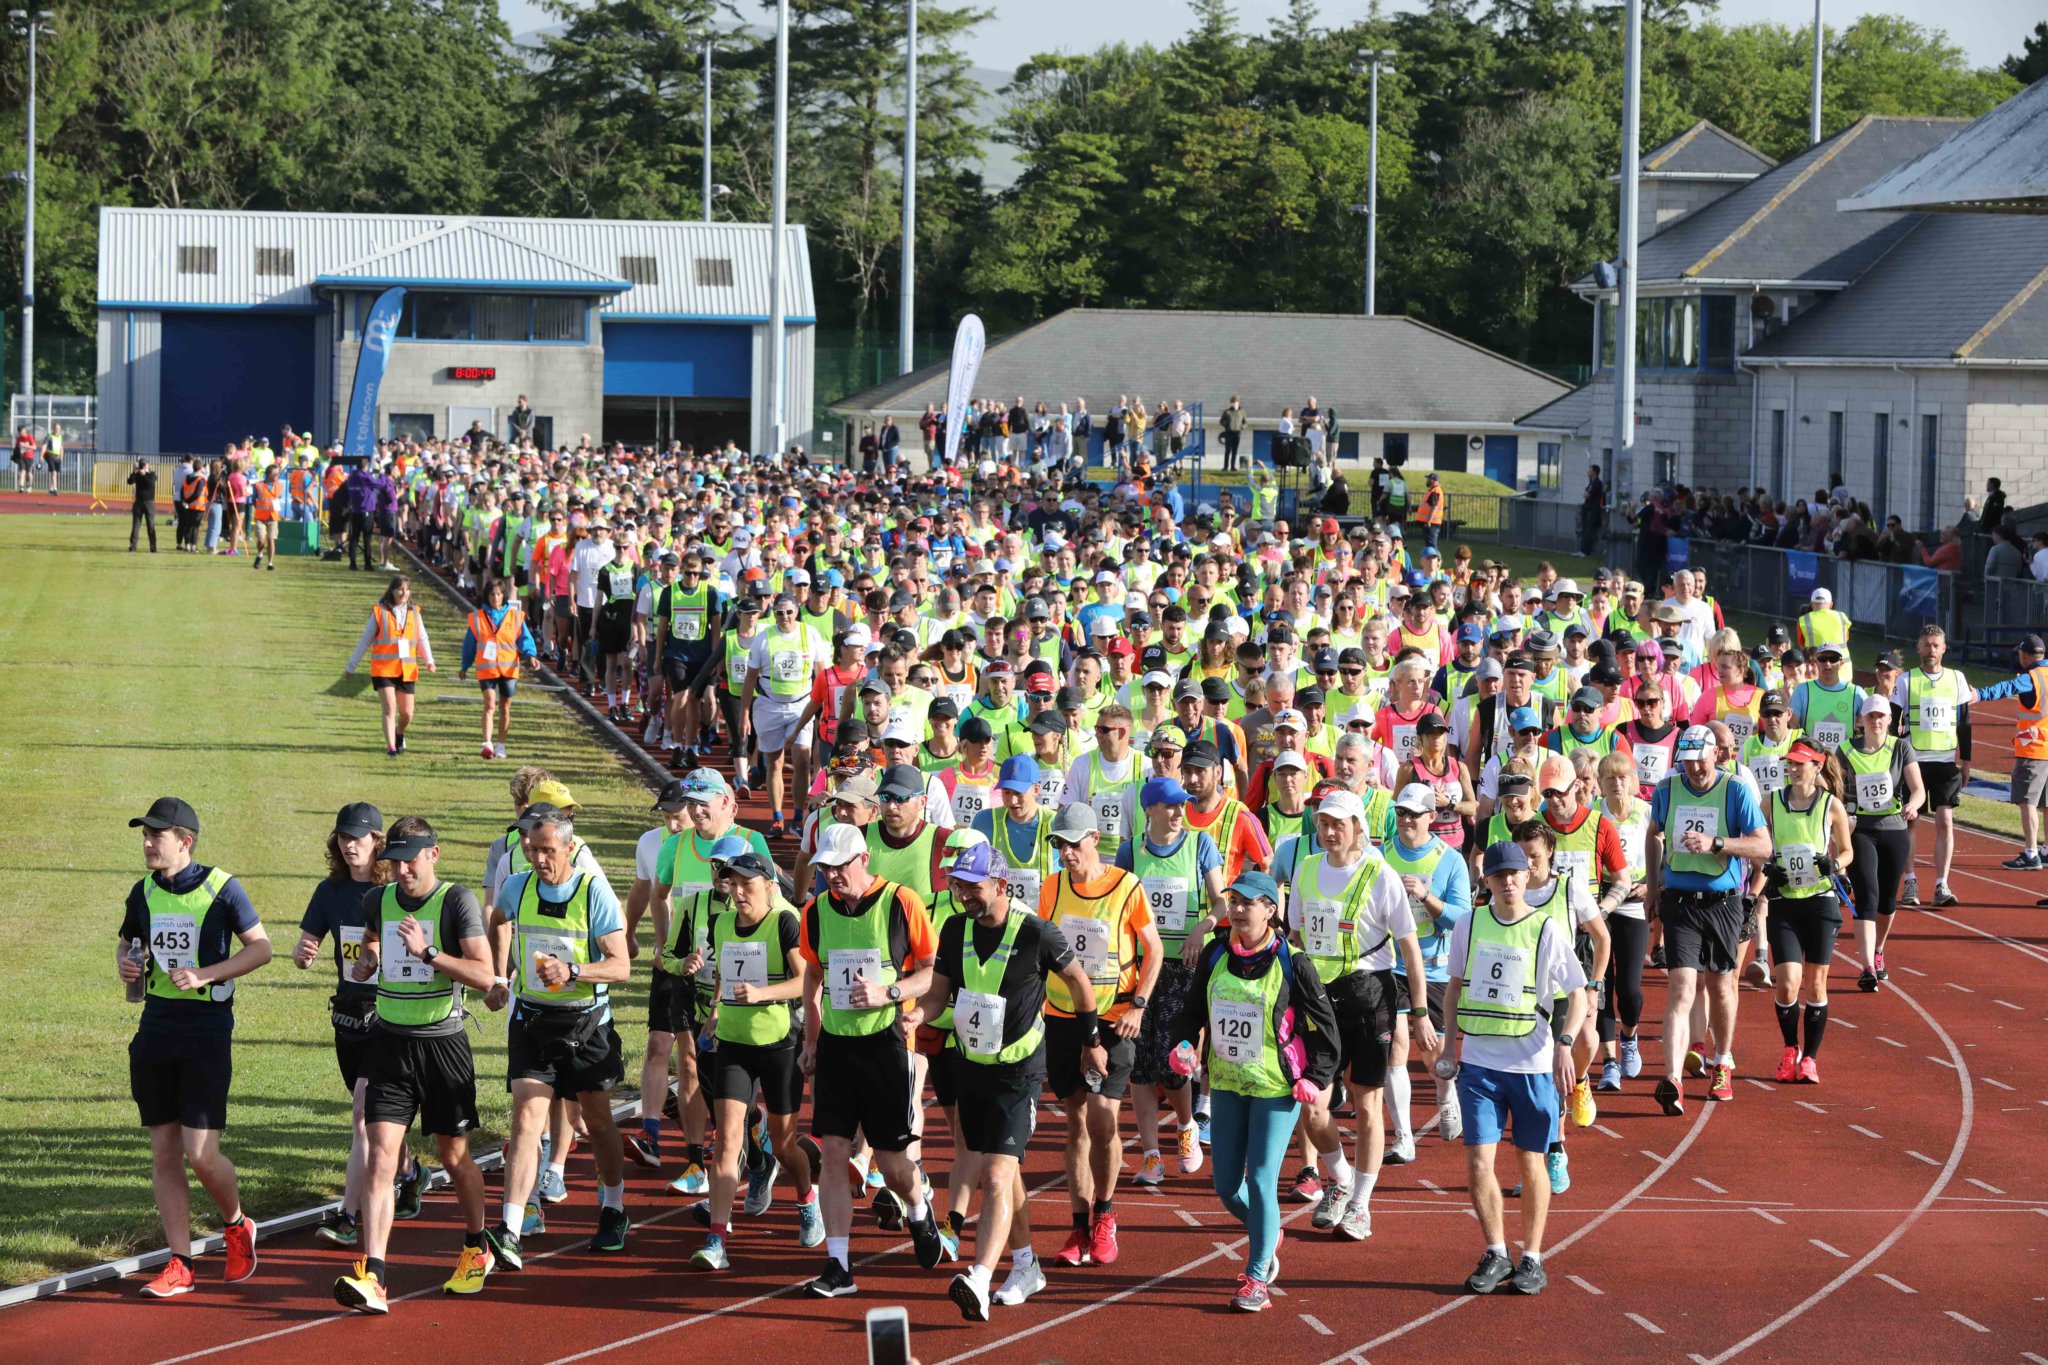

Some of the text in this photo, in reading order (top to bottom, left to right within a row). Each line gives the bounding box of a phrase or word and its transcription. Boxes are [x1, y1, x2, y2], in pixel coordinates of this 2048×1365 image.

[455, 368, 495, 379] 8:00:49
[357, 382, 375, 440] telecom
[678, 622, 695, 631] 278
[1925, 706, 1944, 718] 101
[1728, 723, 1748, 736] 533
[1818, 731, 1840, 743] 888
[1641, 755, 1657, 768] 47
[1754, 766, 1777, 779] 116
[1862, 783, 1887, 798] 135
[957, 795, 983, 811] 139
[1101, 804, 1119, 818] 63
[1684, 819, 1704, 834] 26
[1789, 856, 1804, 871] 60
[1151, 892, 1173, 908] 98
[1321, 906, 1336, 914] walk
[152, 921, 175, 929] parish
[1062, 922, 1105, 934] parish walk
[1311, 915, 1325, 933] 31
[153, 931, 190, 950] 453
[529, 941, 569, 951] parish walk
[1075, 934, 1087, 952] 8
[833, 957, 855, 965] parish
[1479, 950, 1522, 962] parish walk
[734, 960, 745, 977] 7
[1490, 962, 1502, 980] 6
[841, 967, 864, 985] 14
[980, 1002, 1000, 1010] walk
[1215, 1007, 1258, 1018] parish walk
[968, 1011, 980, 1029] 4
[1217, 1018, 1252, 1039] 120
